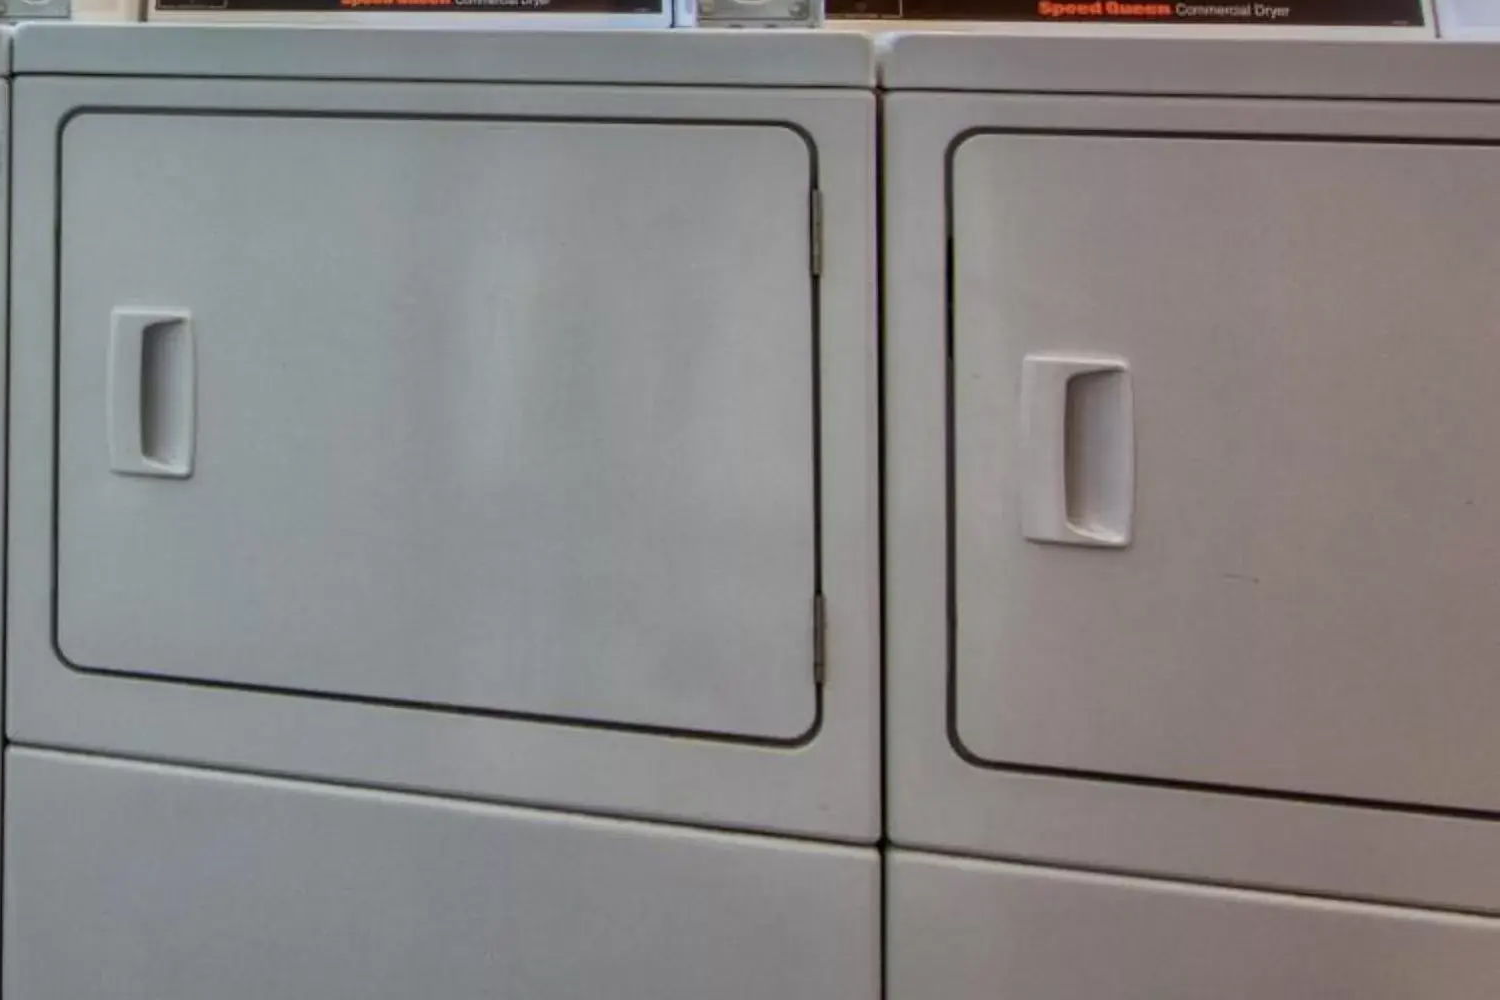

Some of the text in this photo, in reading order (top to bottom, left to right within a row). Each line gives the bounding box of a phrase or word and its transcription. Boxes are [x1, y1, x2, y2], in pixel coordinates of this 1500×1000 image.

[1037, 0, 1291, 19] Speed Queen Commercial Dryer
